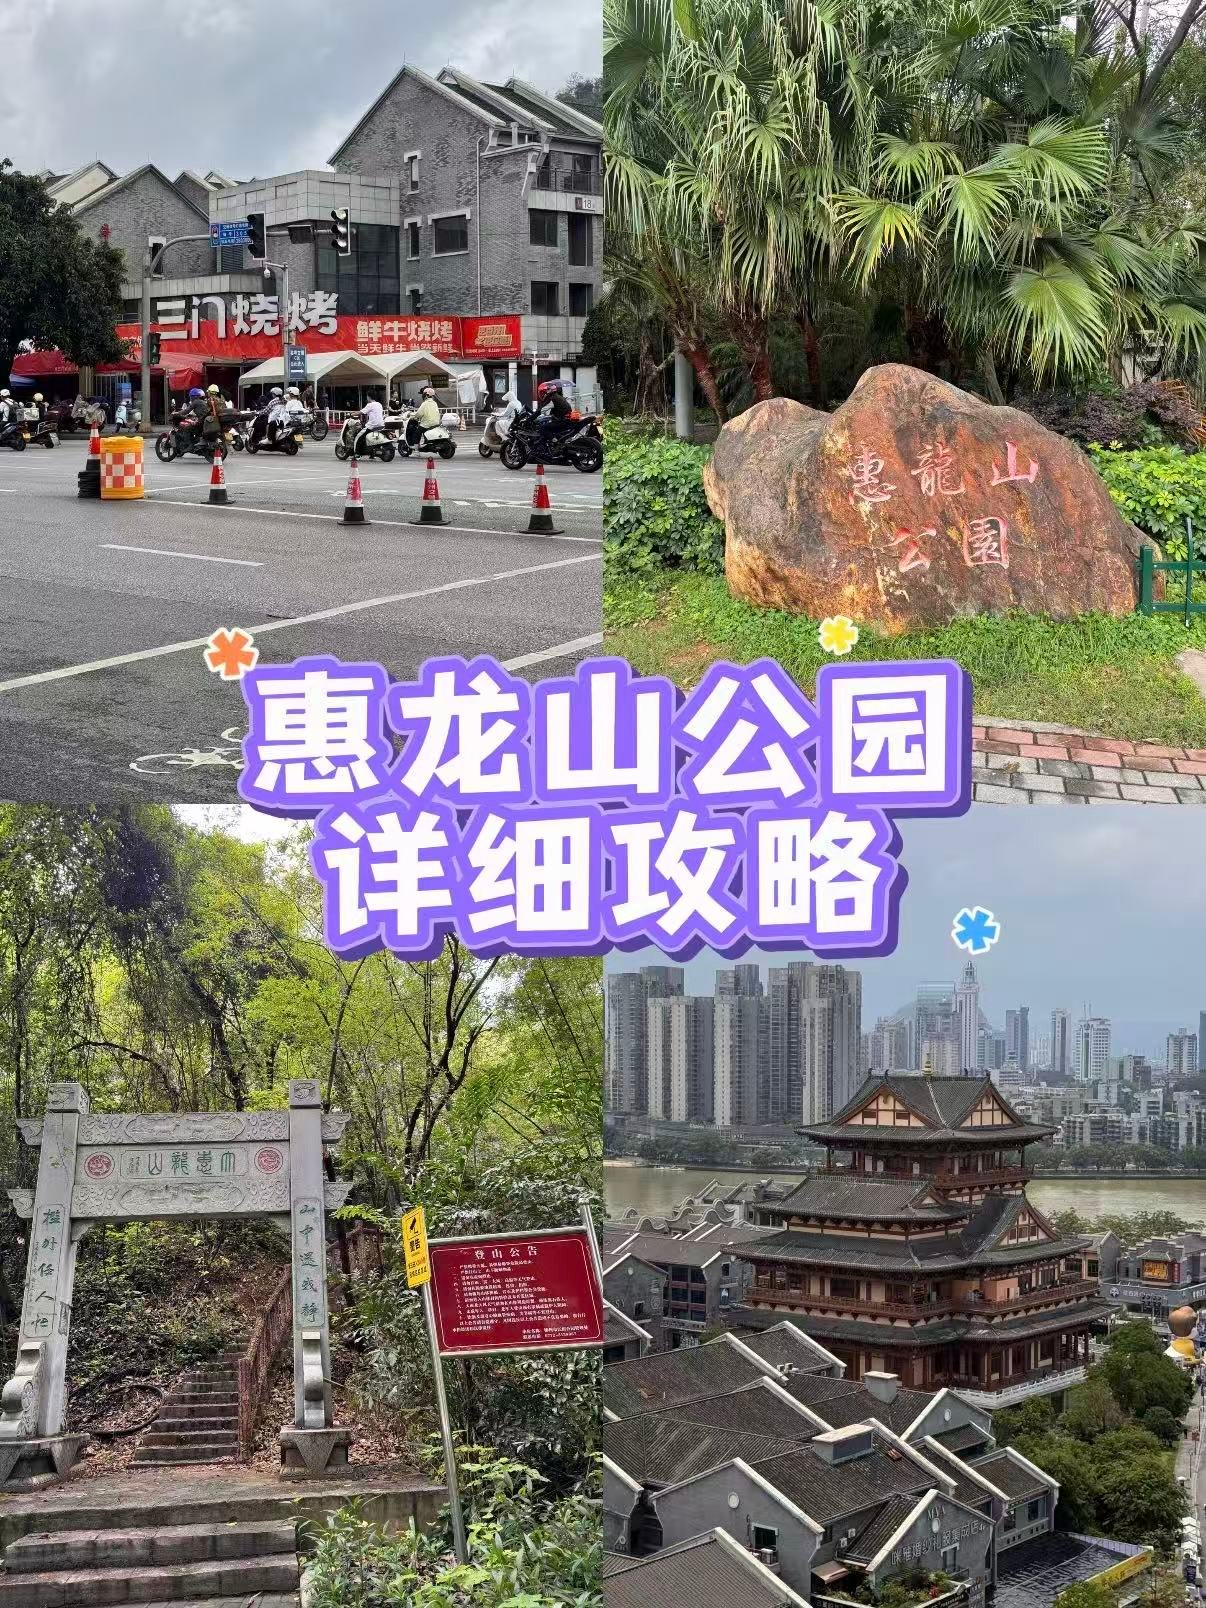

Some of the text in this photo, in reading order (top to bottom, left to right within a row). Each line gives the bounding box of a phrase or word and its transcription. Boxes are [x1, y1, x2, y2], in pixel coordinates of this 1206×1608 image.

[583, 200, 592, 209] 18
[156, 290, 339, 340] 三门烧烤
[356, 320, 453, 342] 鲜牛烧烤
[357, 343, 407, 353] 当天鲜牛
[886, 515, 1010, 574] 公園
[474, 1245, 539, 1260] 登山公告
